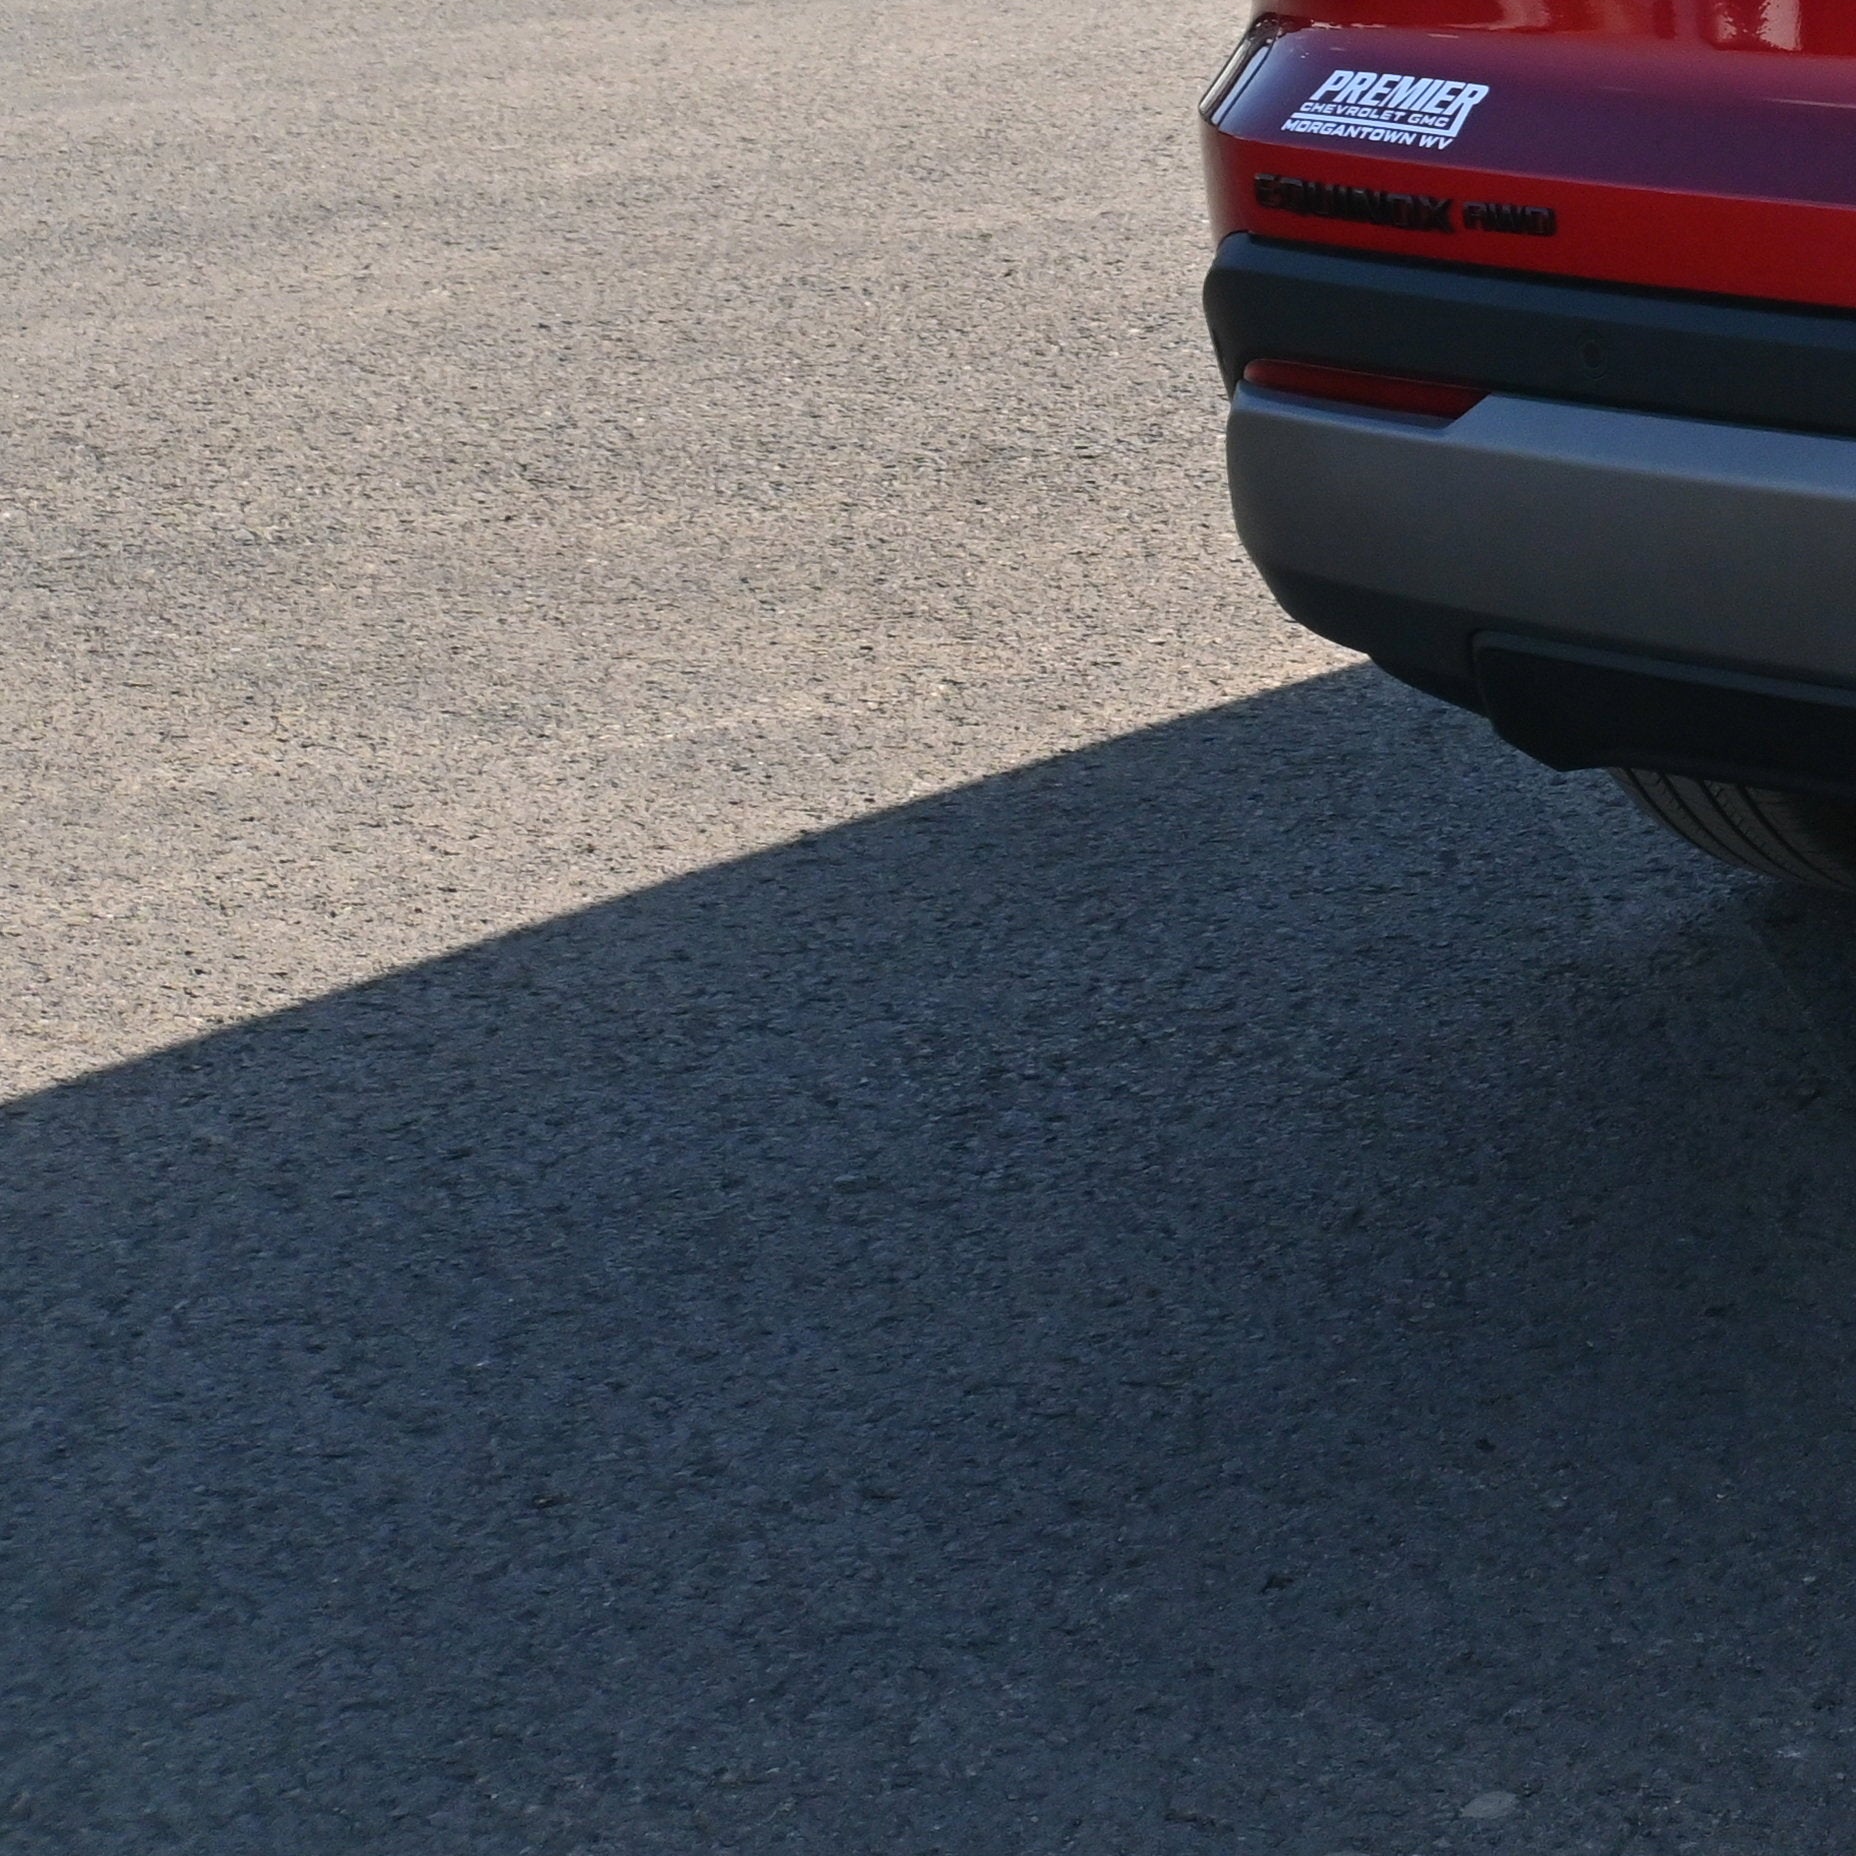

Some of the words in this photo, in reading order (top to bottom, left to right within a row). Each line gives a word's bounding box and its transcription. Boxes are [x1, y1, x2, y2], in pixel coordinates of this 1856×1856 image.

[1299, 101, 1406, 122] CHEVROLET
[1407, 112, 1451, 128] GMC
[1310, 69, 1491, 120] PREMIER
[1281, 118, 1420, 146] MORGANTOWN
[1418, 134, 1453, 150] WV
[1254, 173, 1455, 233] EQUINOX
[1462, 200, 1558, 237] AWD
